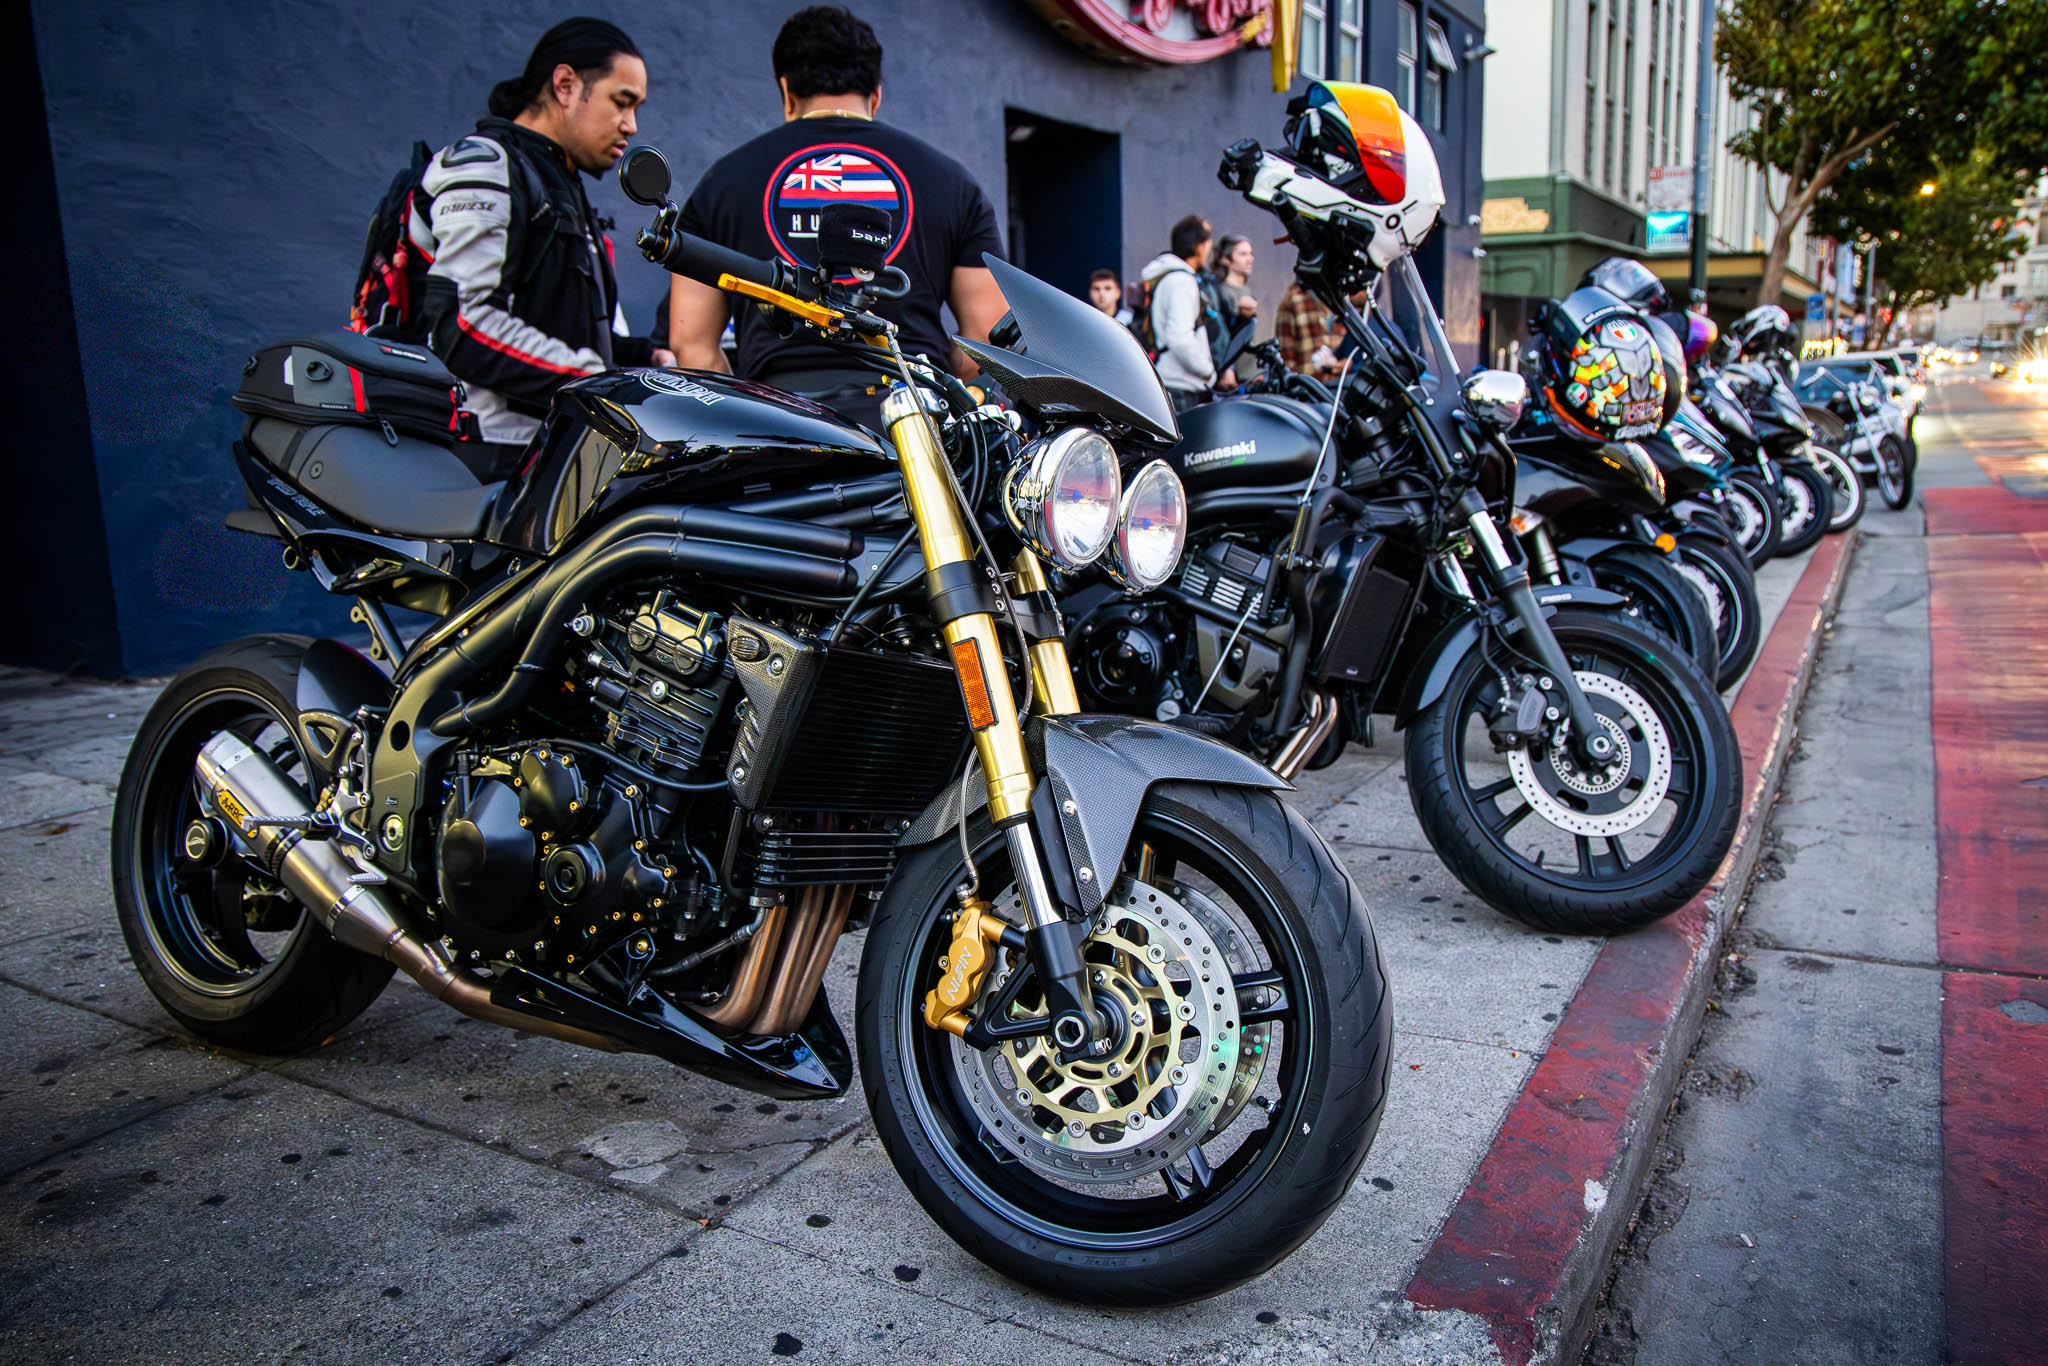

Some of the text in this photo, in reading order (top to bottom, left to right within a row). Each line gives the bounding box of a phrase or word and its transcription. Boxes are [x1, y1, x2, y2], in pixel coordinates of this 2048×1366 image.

[792, 214, 820, 231] HU
[1184, 440, 1256, 467] Kawasaki
[947, 945, 972, 1002] NISSIN
